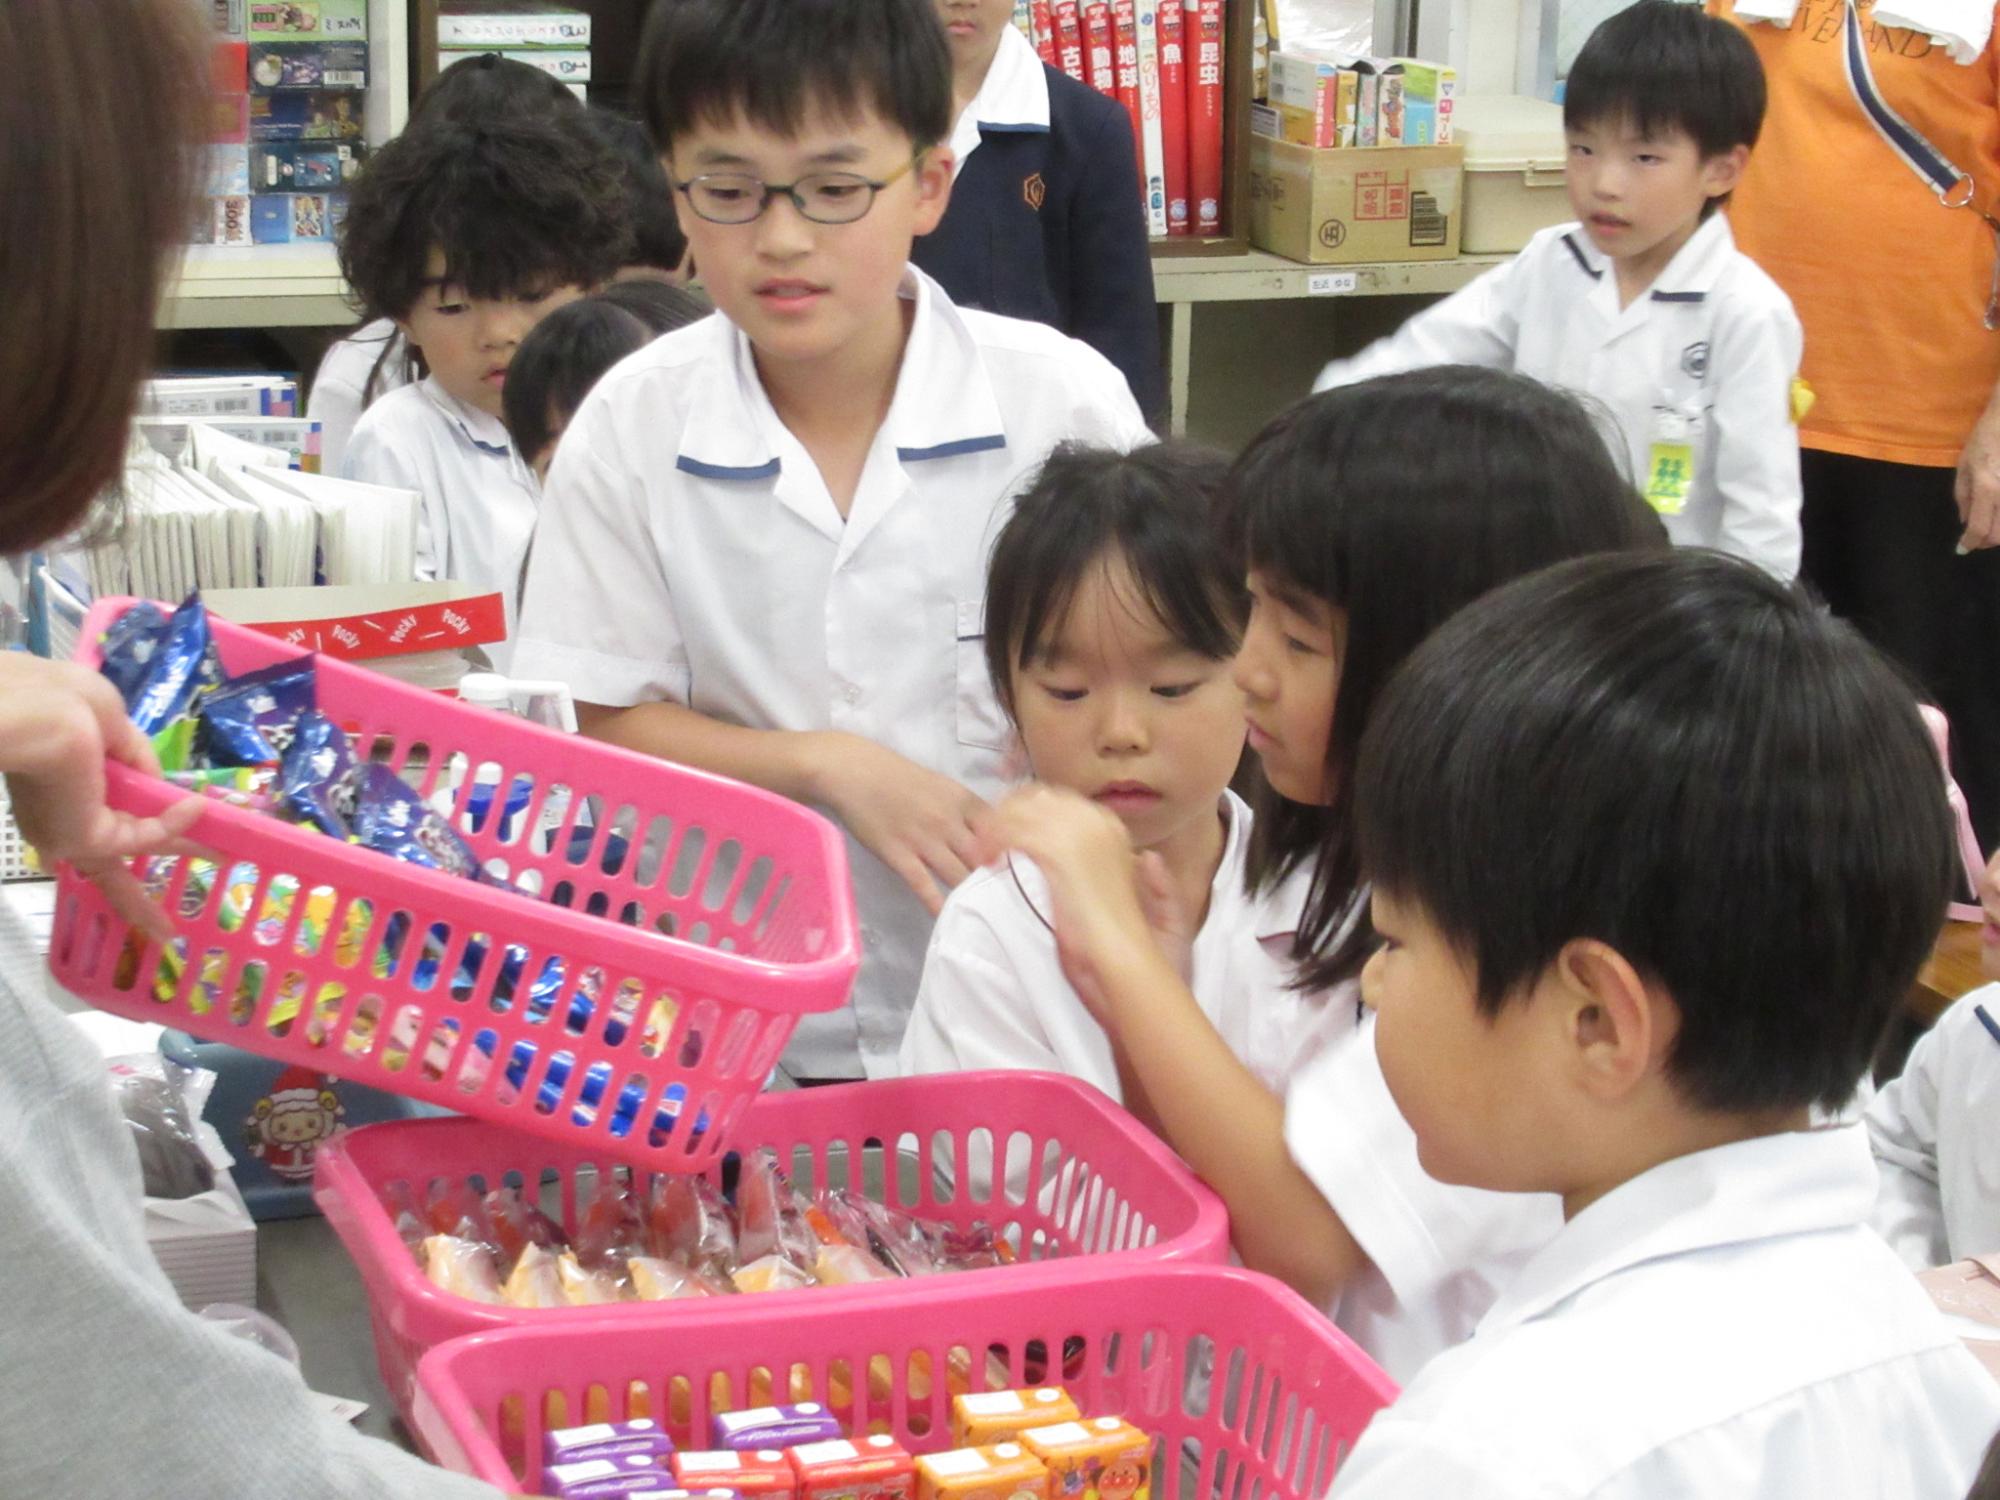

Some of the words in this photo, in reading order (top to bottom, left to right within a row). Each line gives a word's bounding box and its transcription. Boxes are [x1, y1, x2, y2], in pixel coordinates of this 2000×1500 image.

[1091, 47, 1113, 89] 動物
[1118, 43, 1138, 89] 地球
[1162, 43, 1183, 65] 魚
[1199, 42, 1220, 85] 昆虫
[442, 608, 472, 635] Pocky
